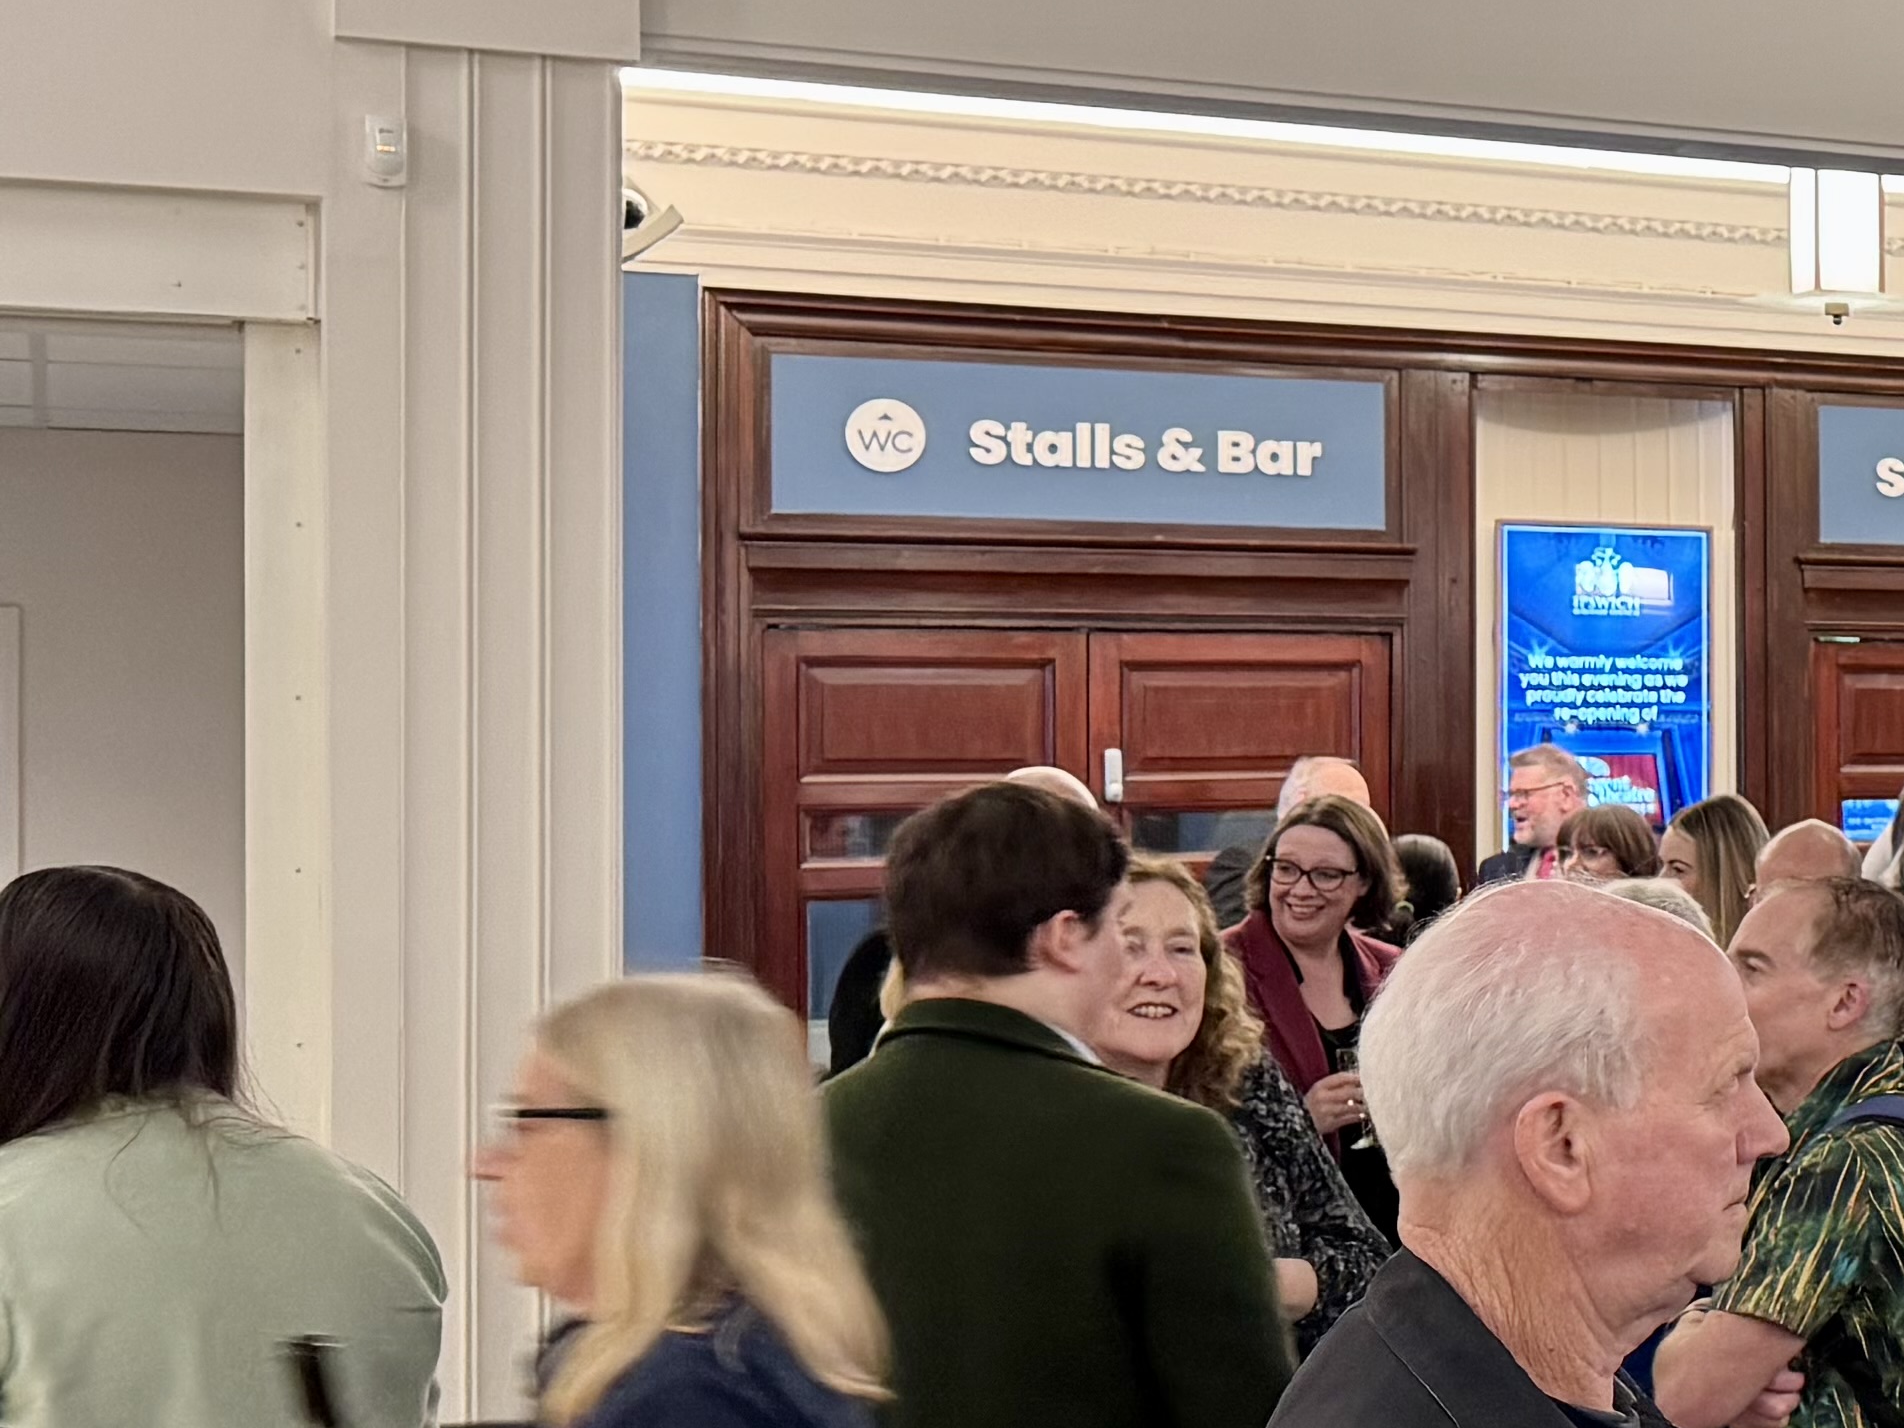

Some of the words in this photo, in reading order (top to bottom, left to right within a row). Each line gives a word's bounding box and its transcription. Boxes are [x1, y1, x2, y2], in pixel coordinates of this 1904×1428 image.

[857, 427, 914, 453] WC
[969, 419, 1146, 471] Stalls
[1156, 427, 1207, 473] &
[1217, 430, 1323, 477] Bar
[1527, 653, 1555, 669] We
[1556, 654, 1613, 672] warmly
[1615, 654, 1684, 670] welcome
[1519, 673, 1549, 688] you
[1551, 671, 1579, 686] this
[1581, 671, 1643, 689] evening
[1643, 674, 1663, 687] as
[1664, 674, 1689, 687] we
[1525, 688, 1585, 706] proudly
[1586, 688, 1658, 703] celebrate
[1659, 688, 1686, 703] the
[1553, 704, 1640, 724] re-opening
[1641, 704, 1658, 721] of
